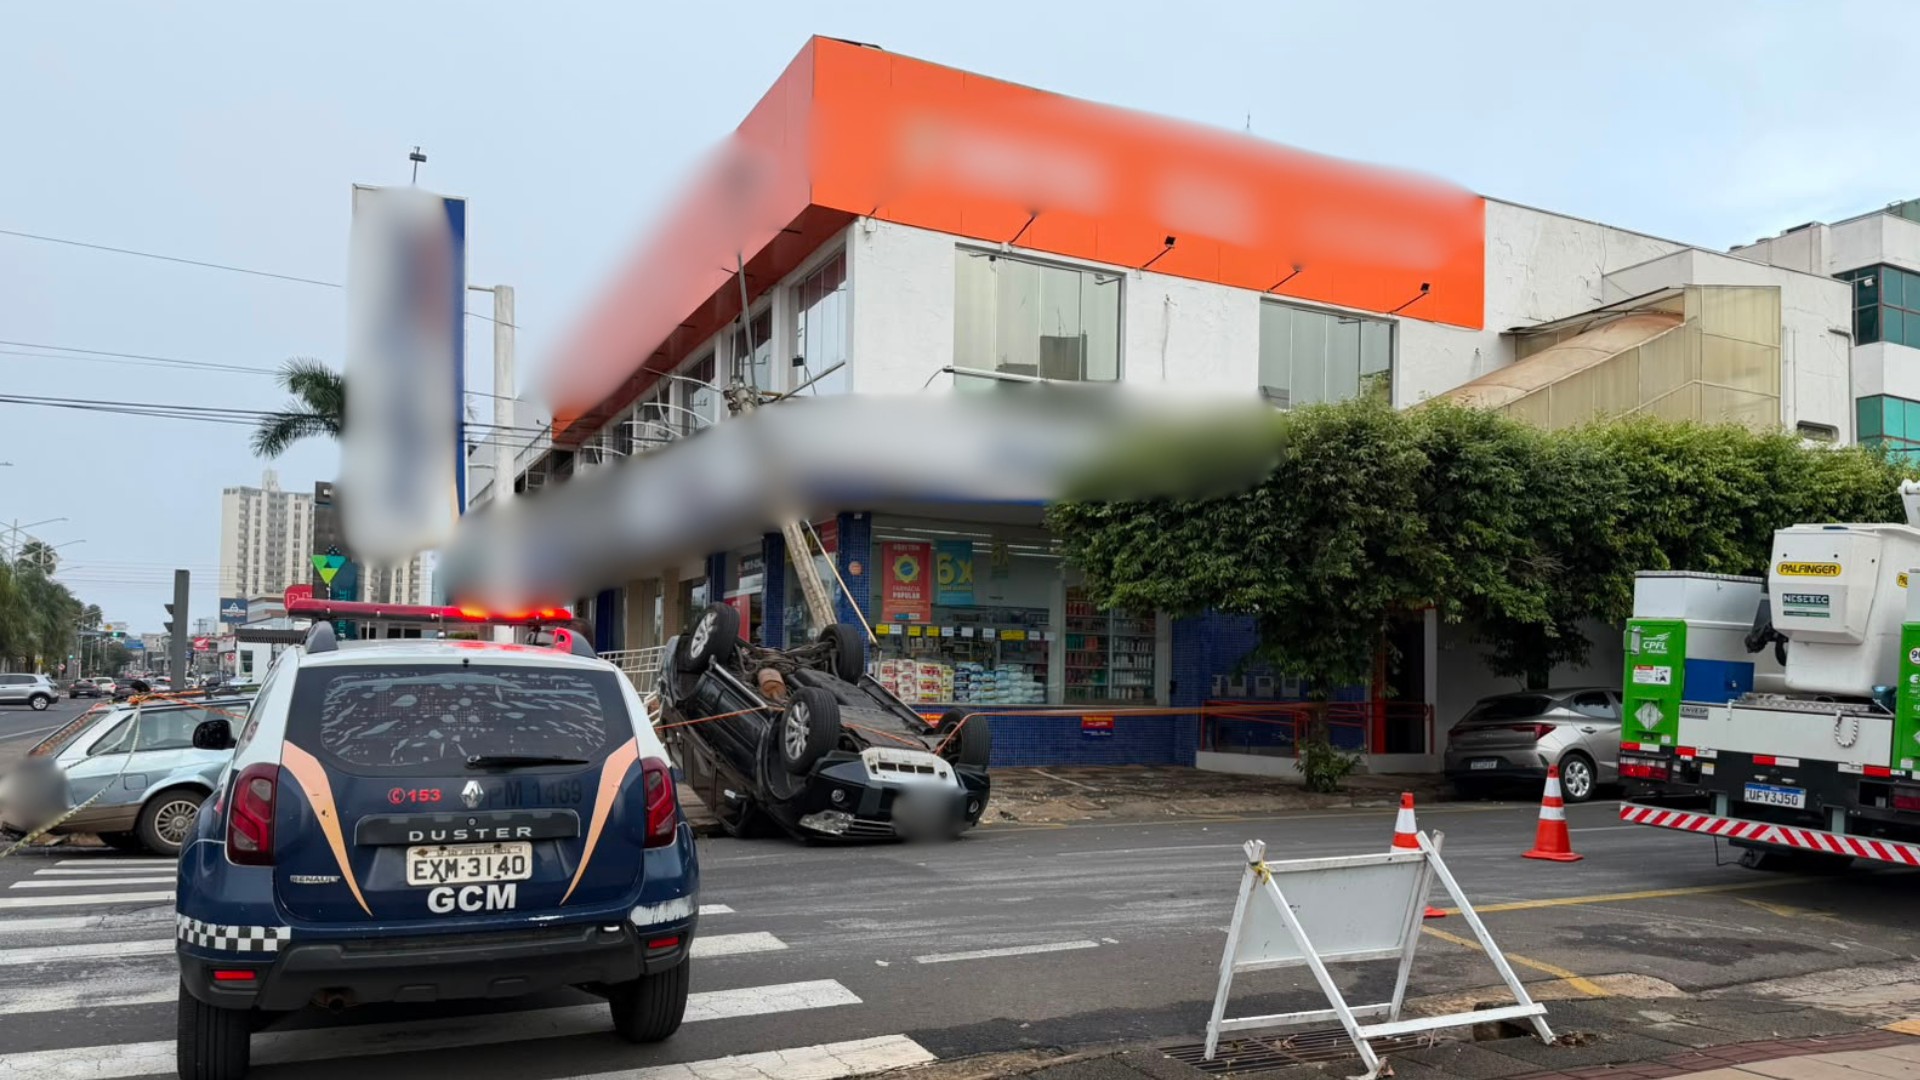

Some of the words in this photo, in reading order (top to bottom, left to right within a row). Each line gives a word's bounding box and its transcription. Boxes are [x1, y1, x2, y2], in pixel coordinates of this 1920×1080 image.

[1780, 564, 1837, 574] PALFINGER
[1642, 641, 1667, 650] CPFL
[408, 789, 442, 802] 153
[409, 827, 532, 842] DUSTER
[290, 875, 341, 883] RENAULT
[427, 883, 517, 913] GCM
